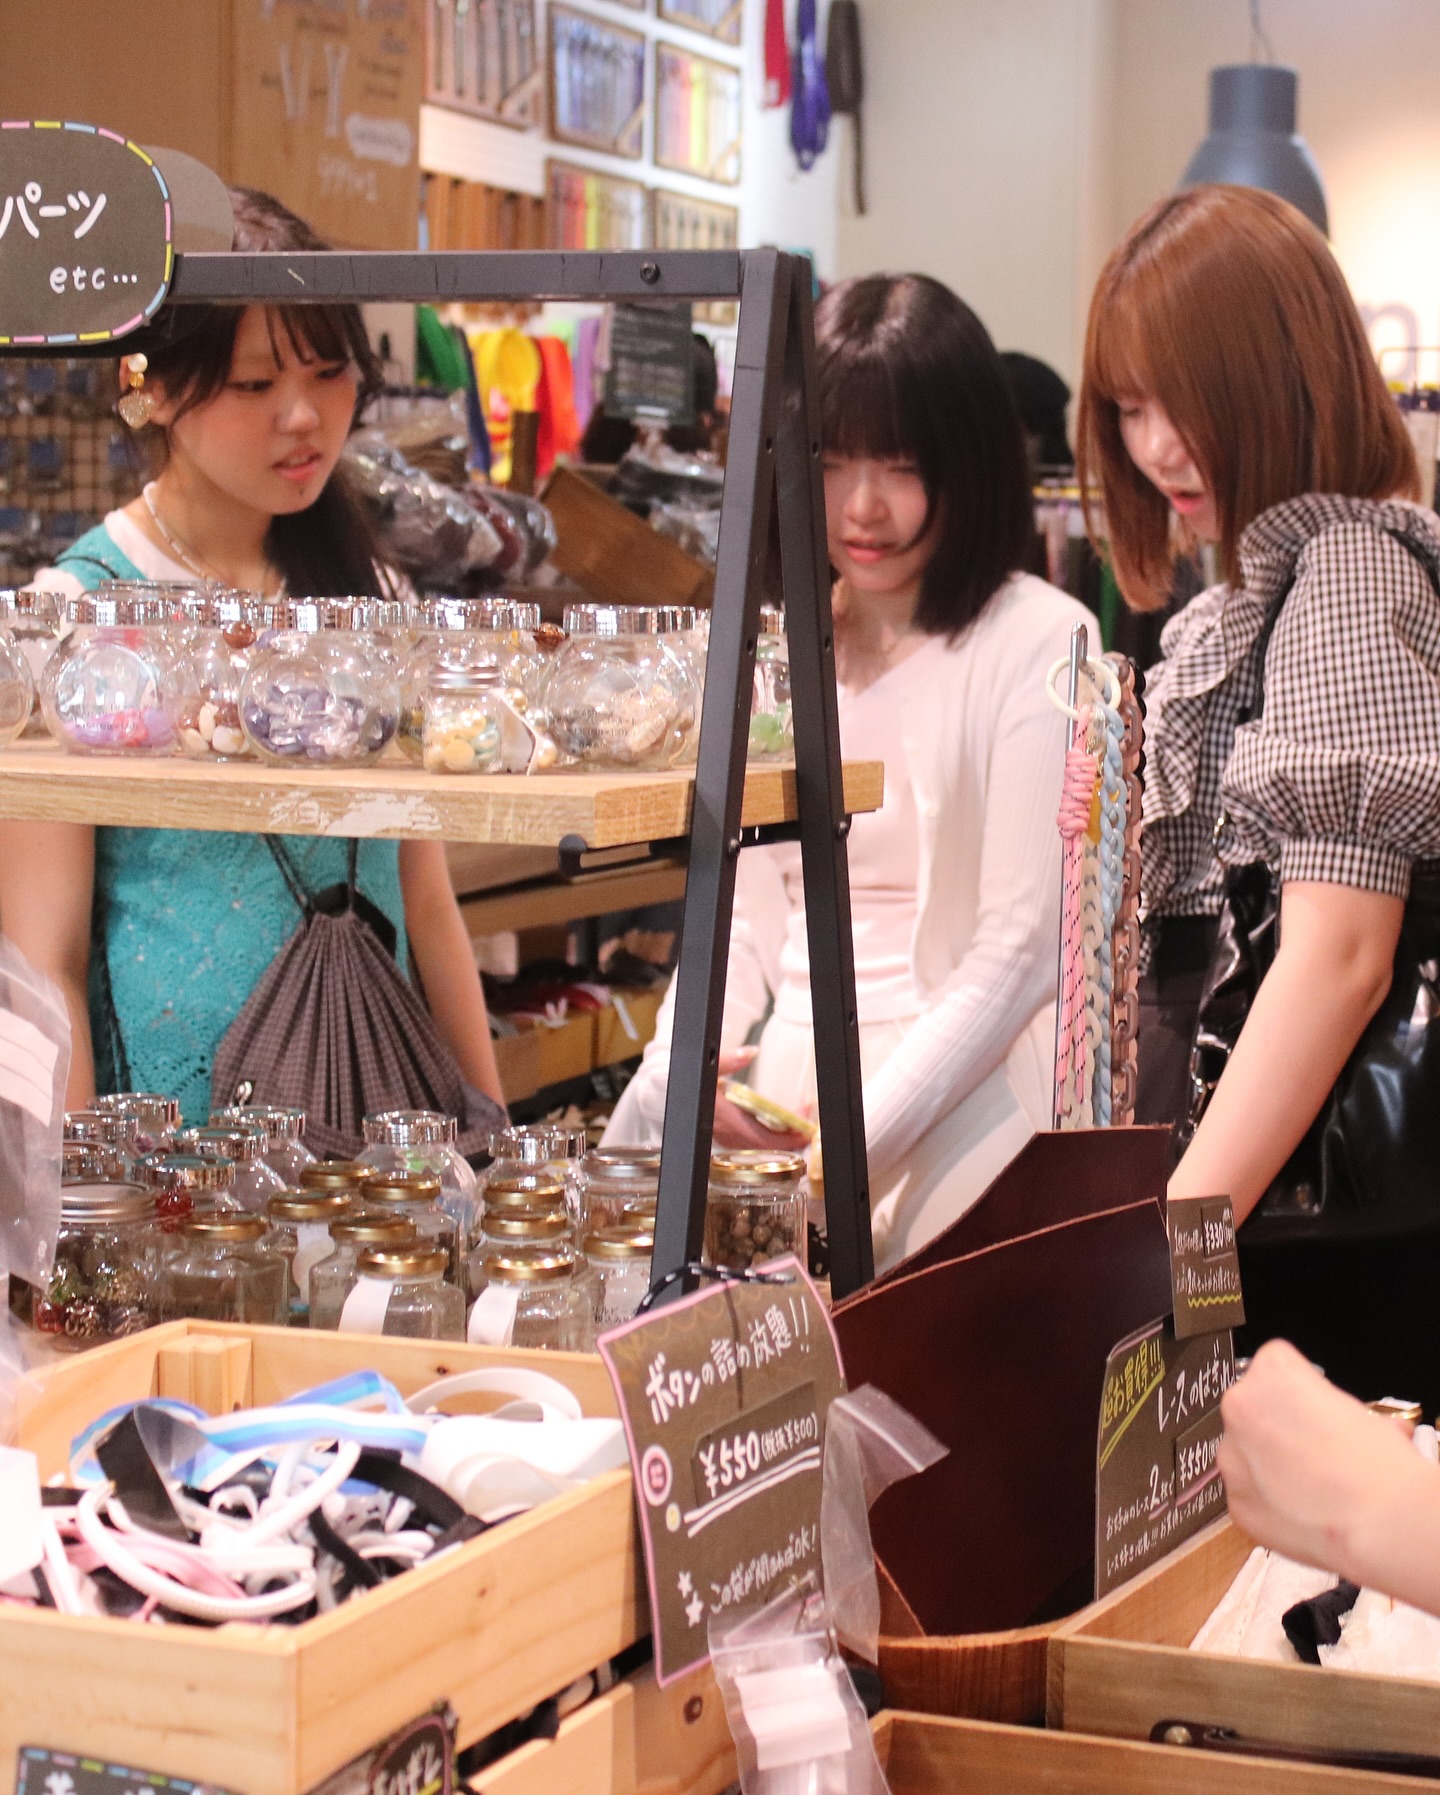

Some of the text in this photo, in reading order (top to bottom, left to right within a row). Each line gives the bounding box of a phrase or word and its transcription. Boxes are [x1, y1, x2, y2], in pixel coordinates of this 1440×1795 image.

[0, 181, 107, 240] パーツ
[645, 1296, 811, 1425] ボタンの詰め放題!!
